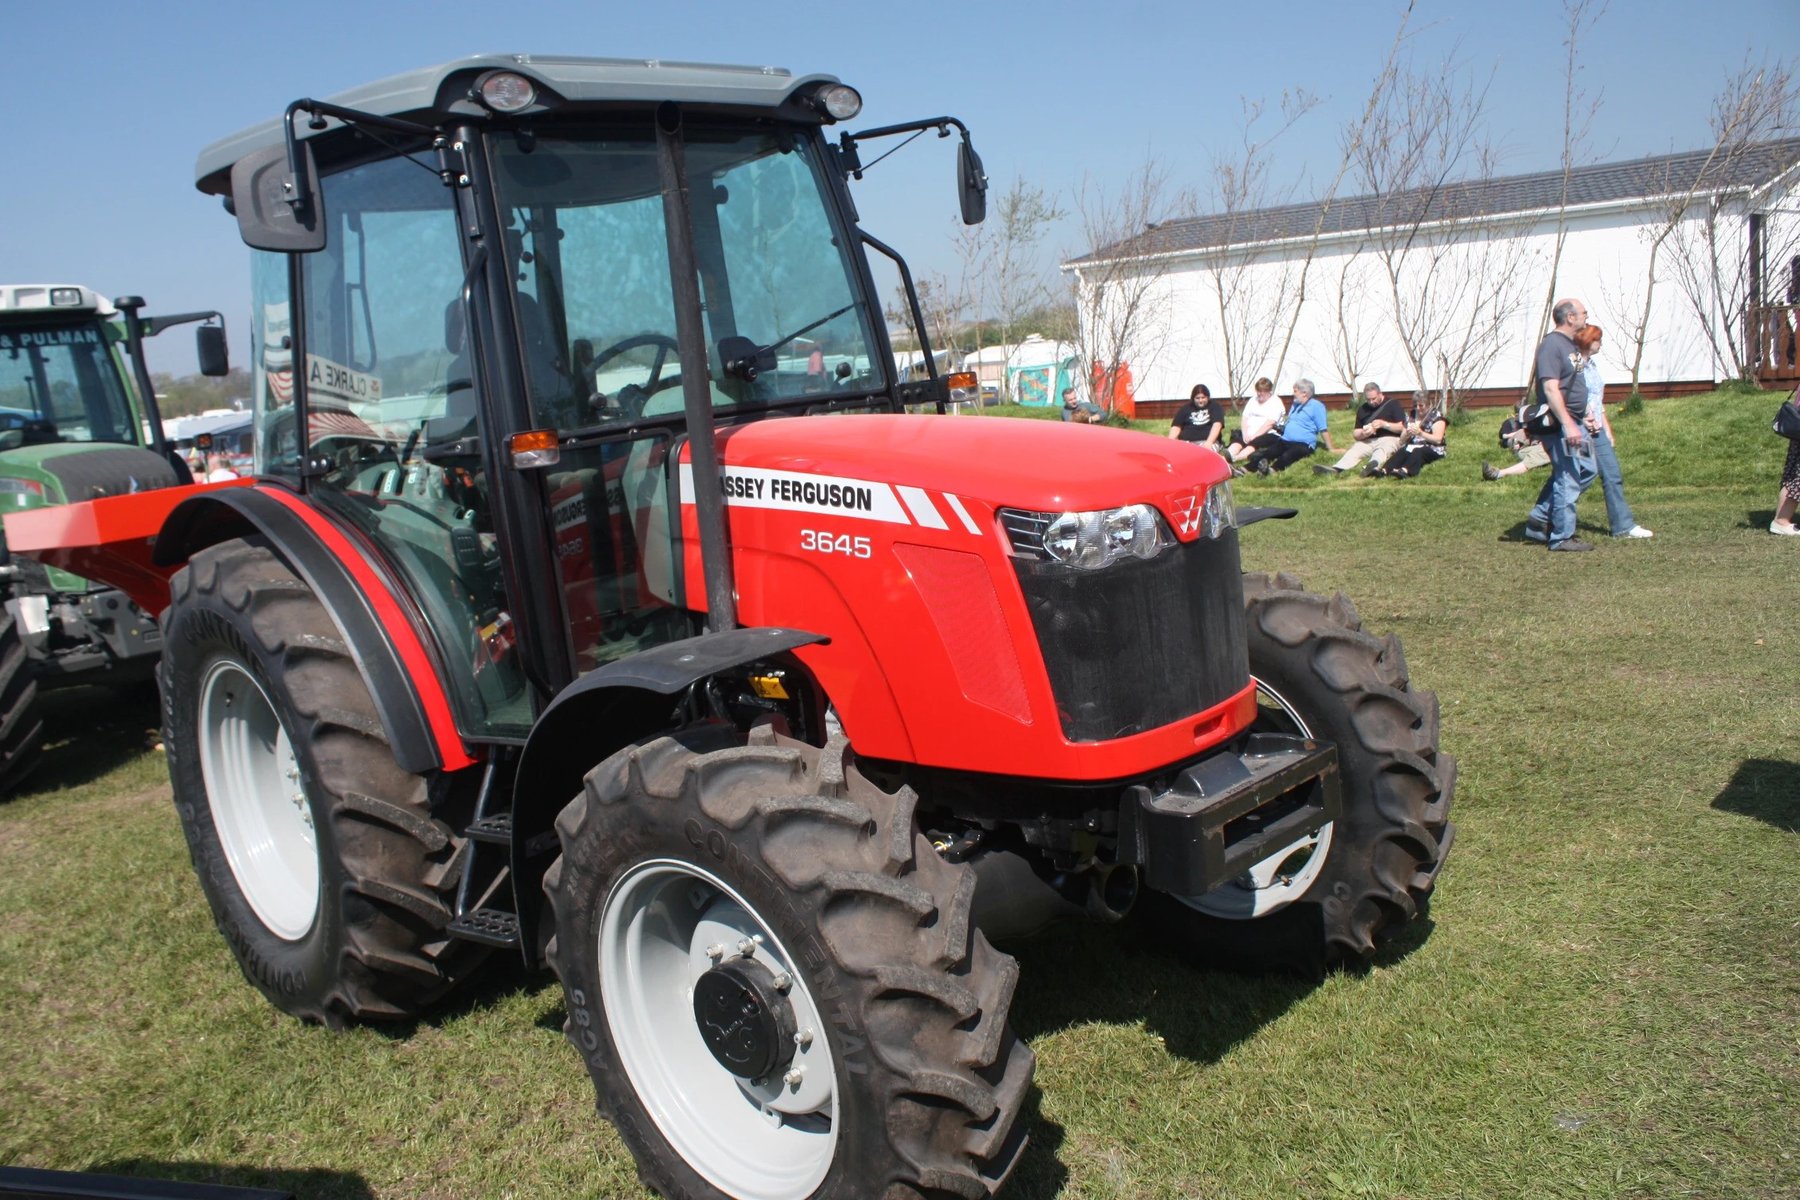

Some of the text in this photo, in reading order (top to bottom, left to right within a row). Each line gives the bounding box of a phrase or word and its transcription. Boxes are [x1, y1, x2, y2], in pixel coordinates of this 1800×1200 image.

[0, 330, 98, 347] & PULMAN
[720, 475, 872, 511] SSEY FERGUSON
[801, 529, 871, 558] 3645
[569, 988, 608, 1070] AC85
